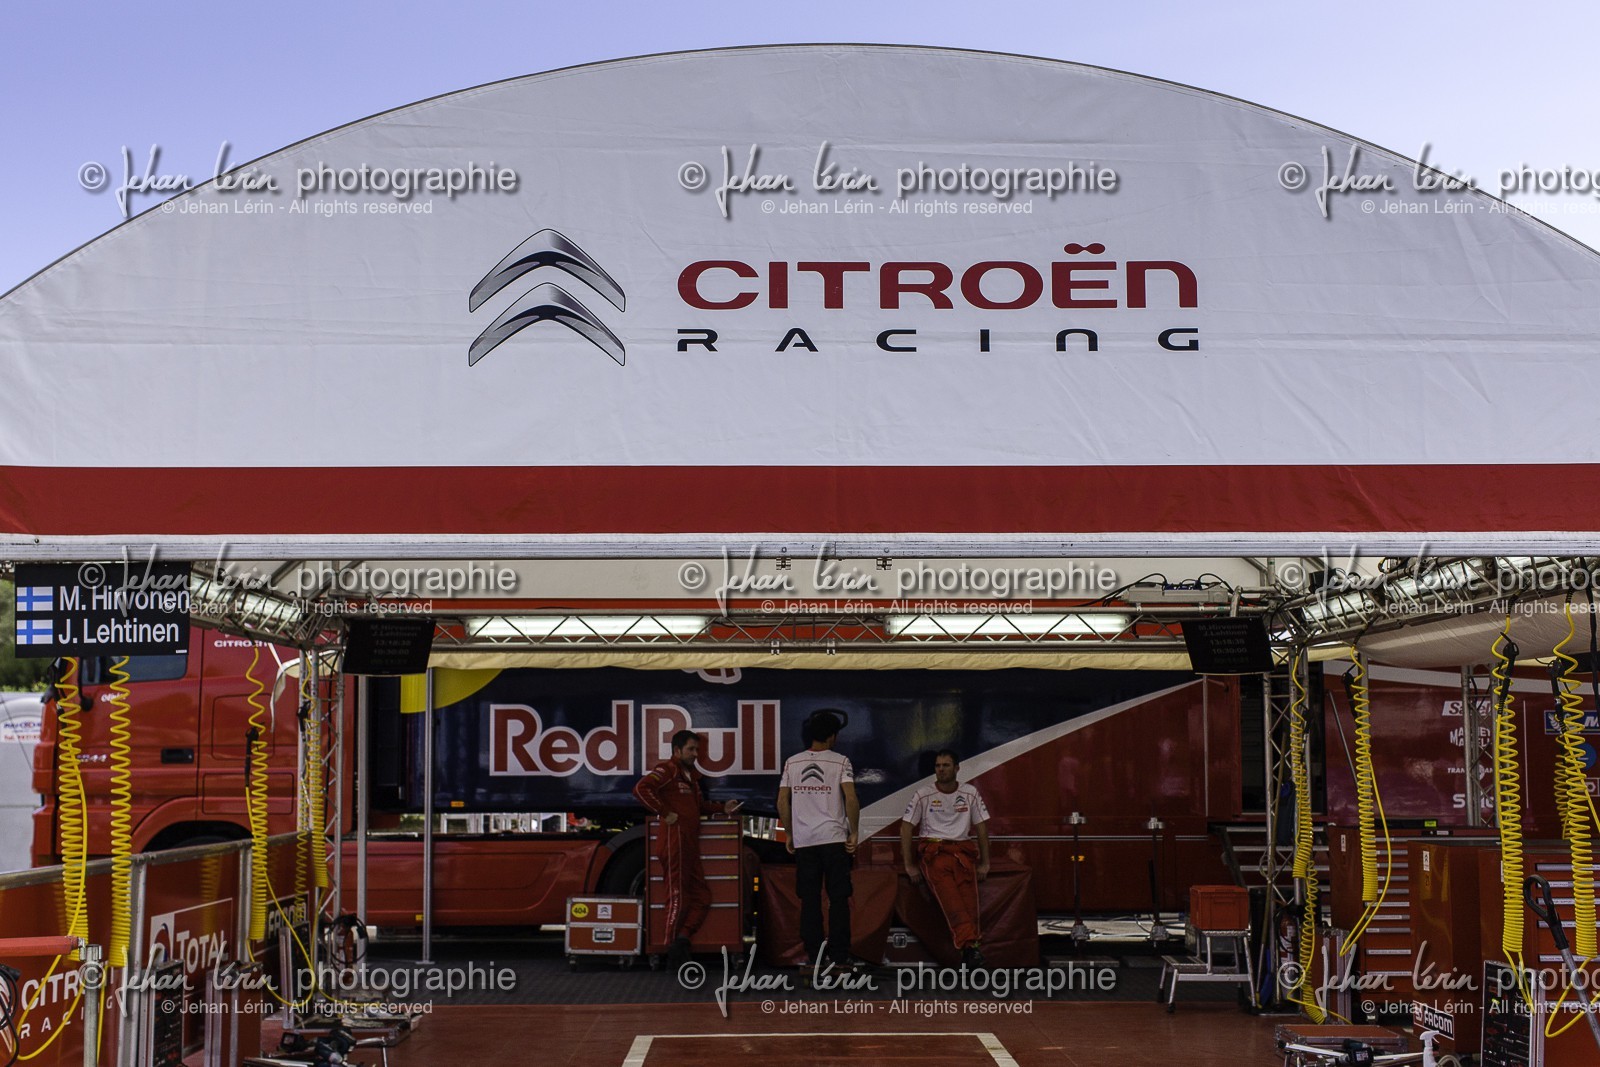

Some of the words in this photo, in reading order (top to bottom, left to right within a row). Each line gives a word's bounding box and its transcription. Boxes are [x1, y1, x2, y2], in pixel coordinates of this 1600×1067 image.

[677, 243, 1198, 310] CITROËN
[677, 328, 1199, 352] RACING
[59, 586, 86, 611] M.
[92, 584, 190, 611] Hirvonen
[58, 618, 77, 645] J.
[84, 617, 179, 644] Lehtinen
[490, 700, 634, 777] Red
[642, 700, 780, 777] Bull
[176, 929, 229, 974] TOTAL
[1424, 1010, 1453, 1035] FACOM
